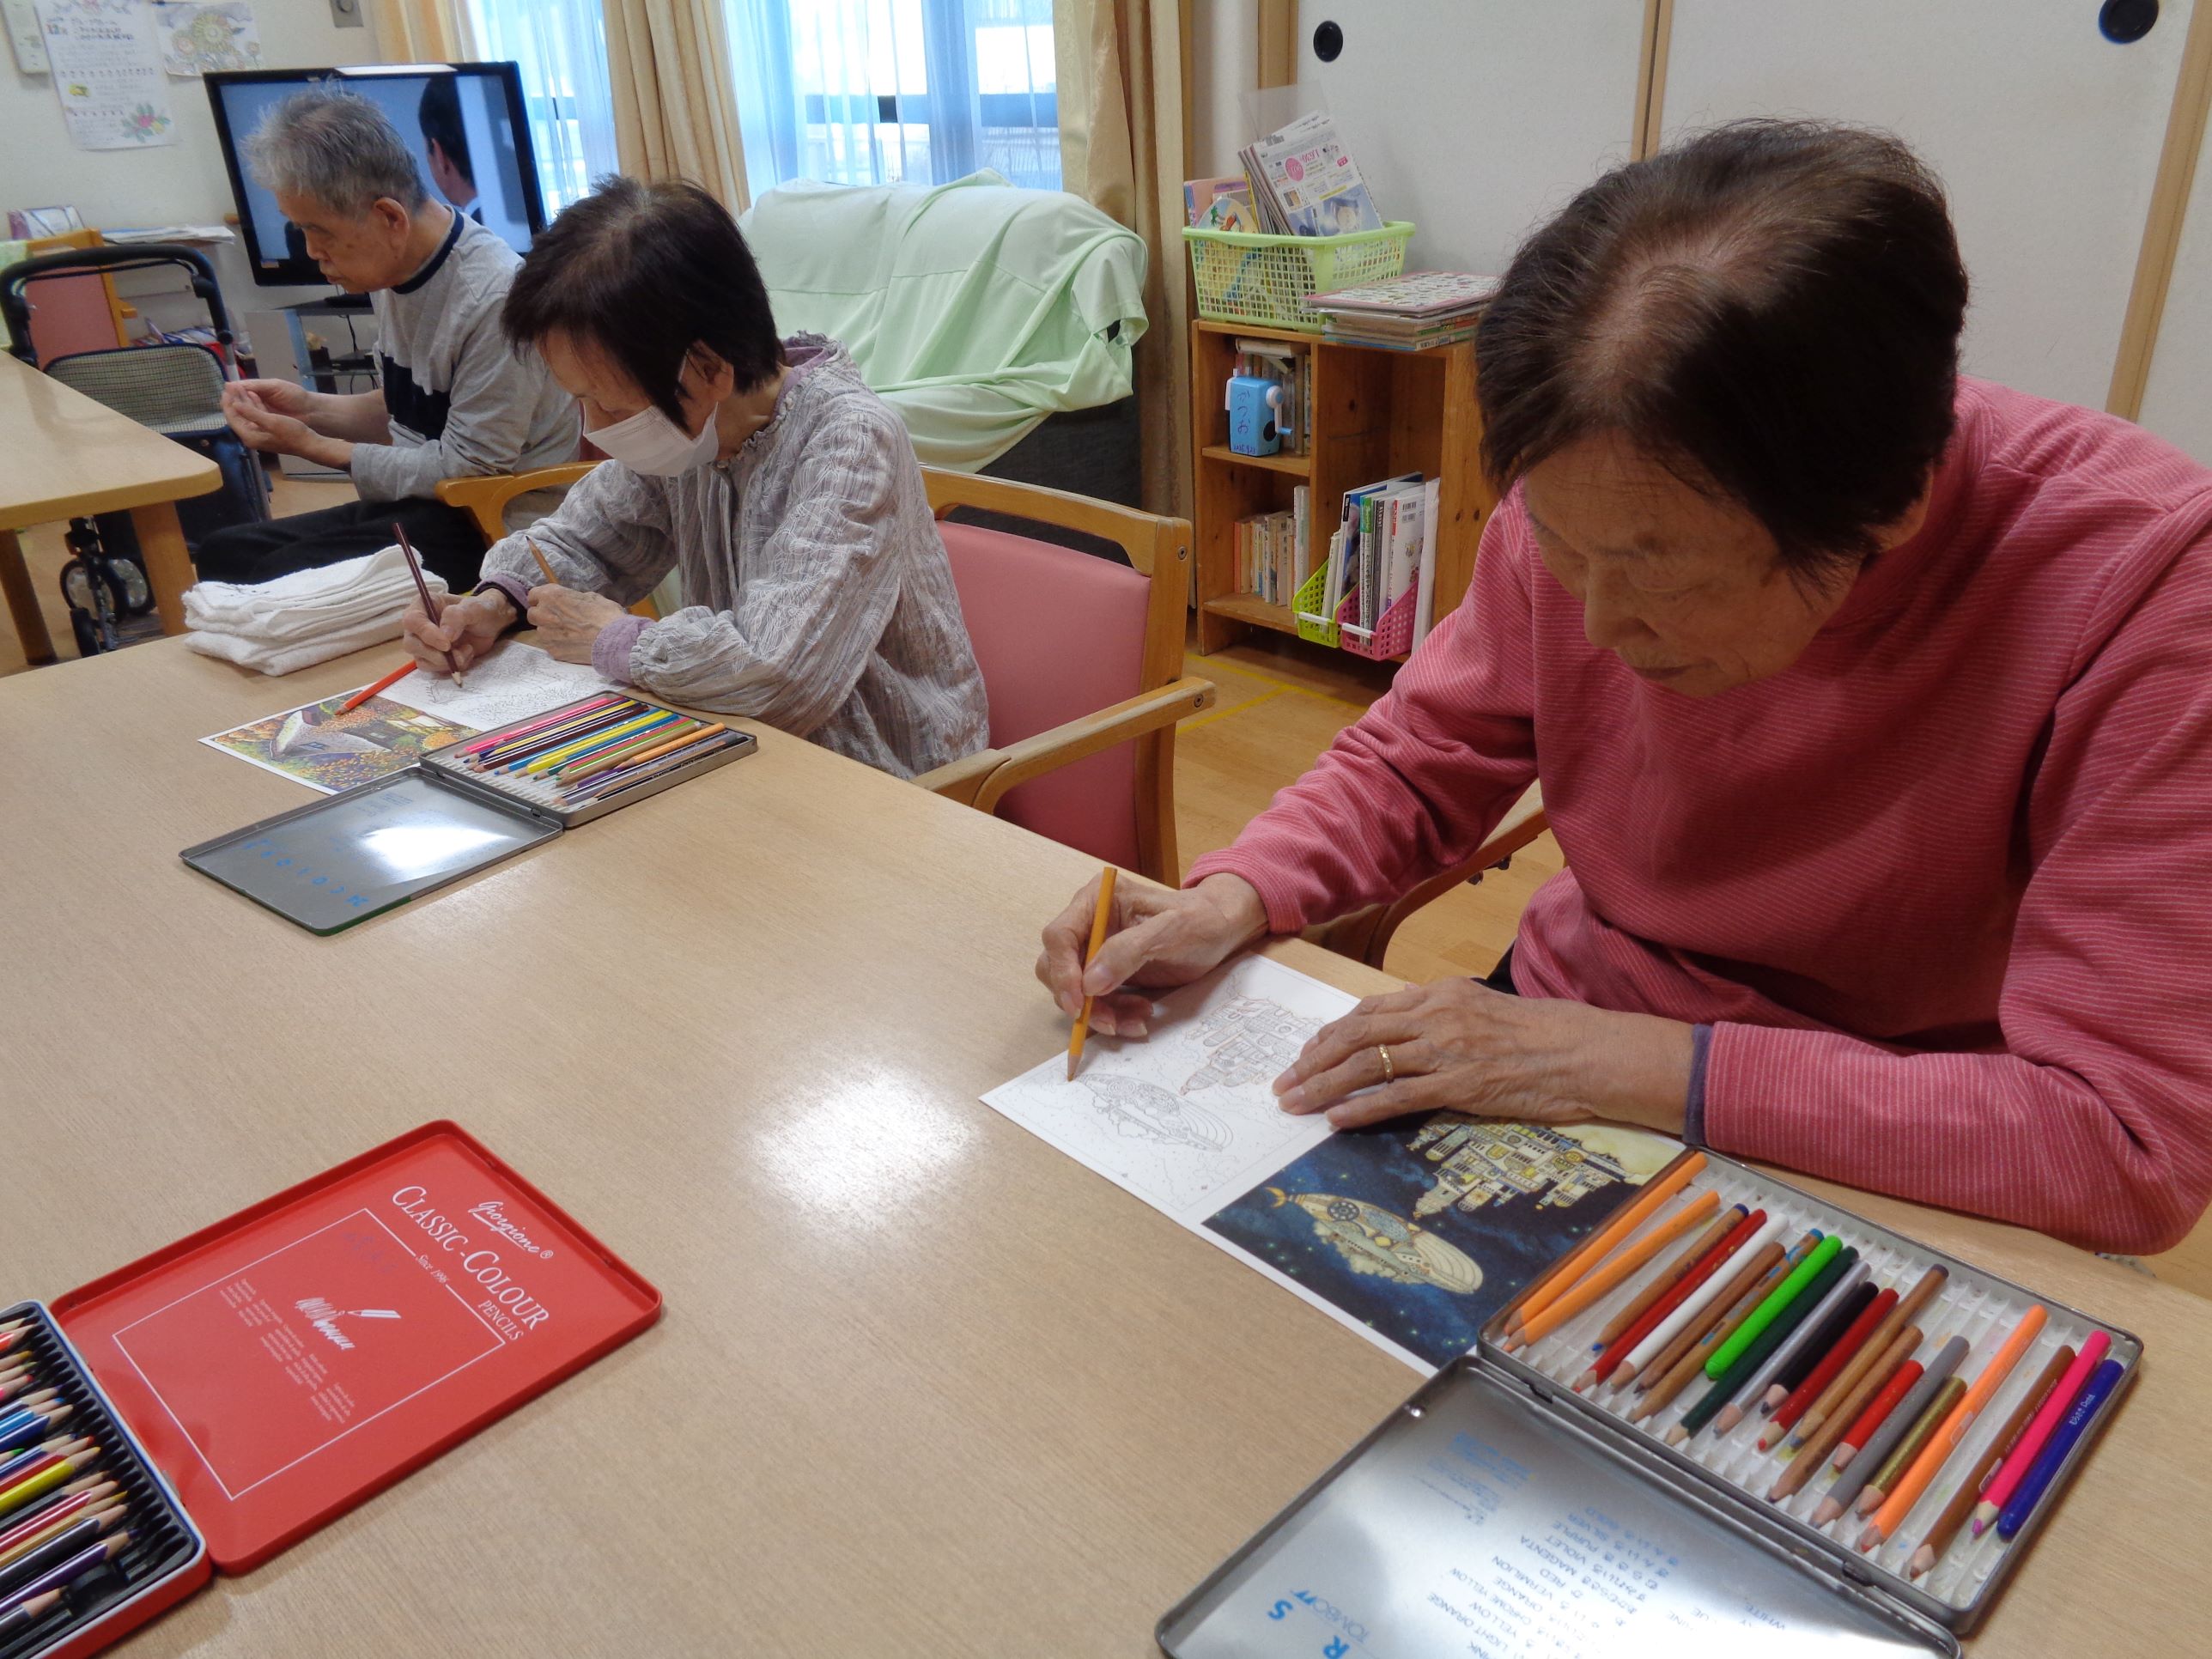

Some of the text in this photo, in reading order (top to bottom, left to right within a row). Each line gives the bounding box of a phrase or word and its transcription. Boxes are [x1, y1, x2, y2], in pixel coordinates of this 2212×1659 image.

[478, 1300, 524, 1340] PENCILS
[1551, 1520, 1600, 1553] PURPLE
[1566, 1512, 1610, 1542] SILVER
[1517, 1534, 1578, 1577] MAGENTA
[1545, 1534, 1588, 1565] VIOLET
[1449, 1566, 1489, 1598] YELLOW
[1491, 1555, 1553, 1600] VERMILION
[1538, 1567, 1567, 1589] RED
[1488, 1593, 1534, 1626] CHROME
[1492, 1576, 1545, 1613] ORANGE
[1426, 1592, 1509, 1651] LIGHT ORANGE
[1467, 1600, 1518, 1638] YELLOW
[1742, 1602, 1785, 1632] WHITE
